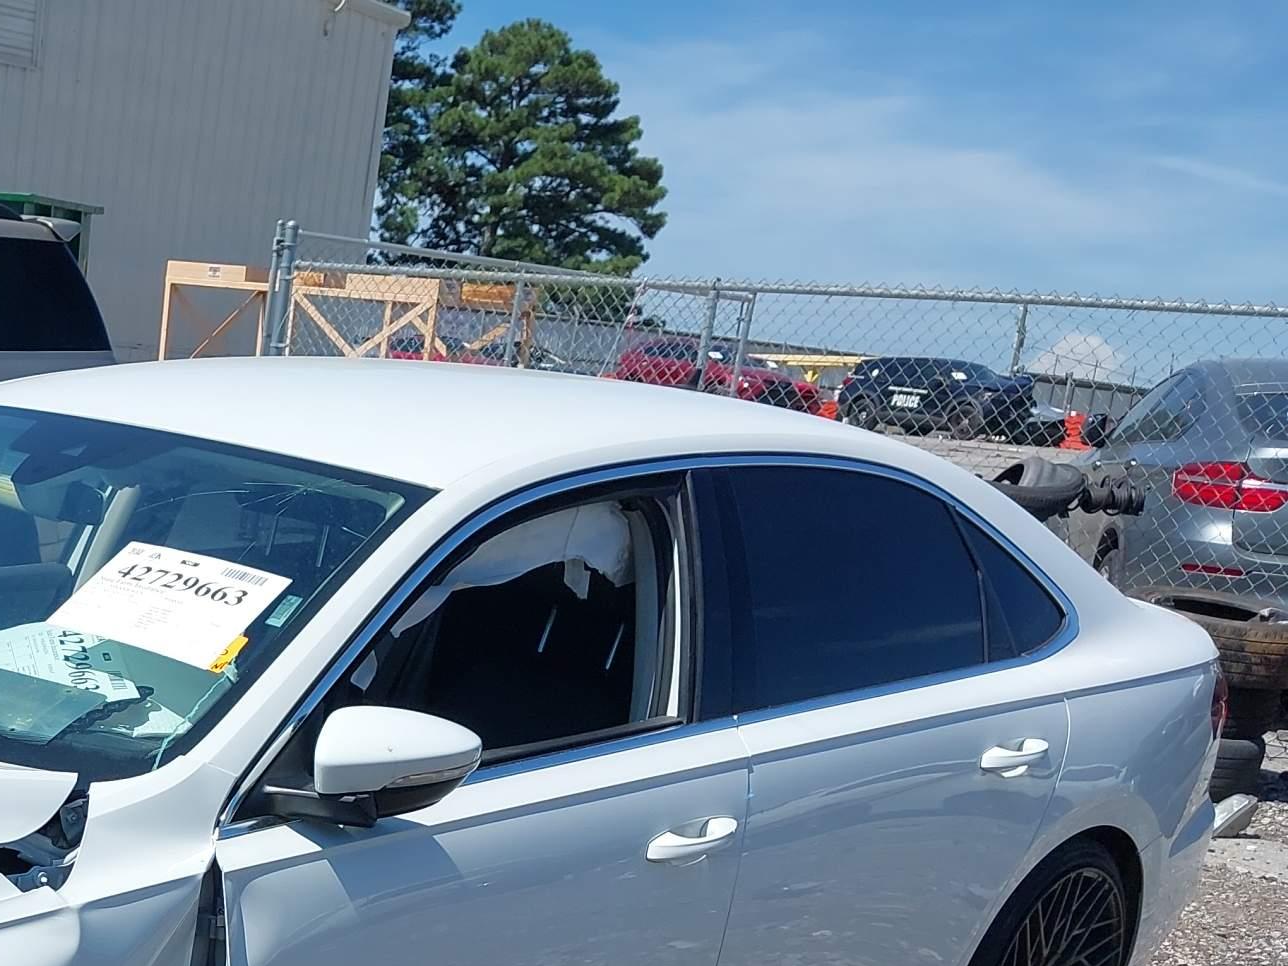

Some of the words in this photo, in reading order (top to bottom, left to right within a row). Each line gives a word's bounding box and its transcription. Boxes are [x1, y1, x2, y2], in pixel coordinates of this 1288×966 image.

[890, 393, 921, 409] POLICE
[117, 563, 249, 607] 42729663
[57, 629, 101, 692] 42729663
